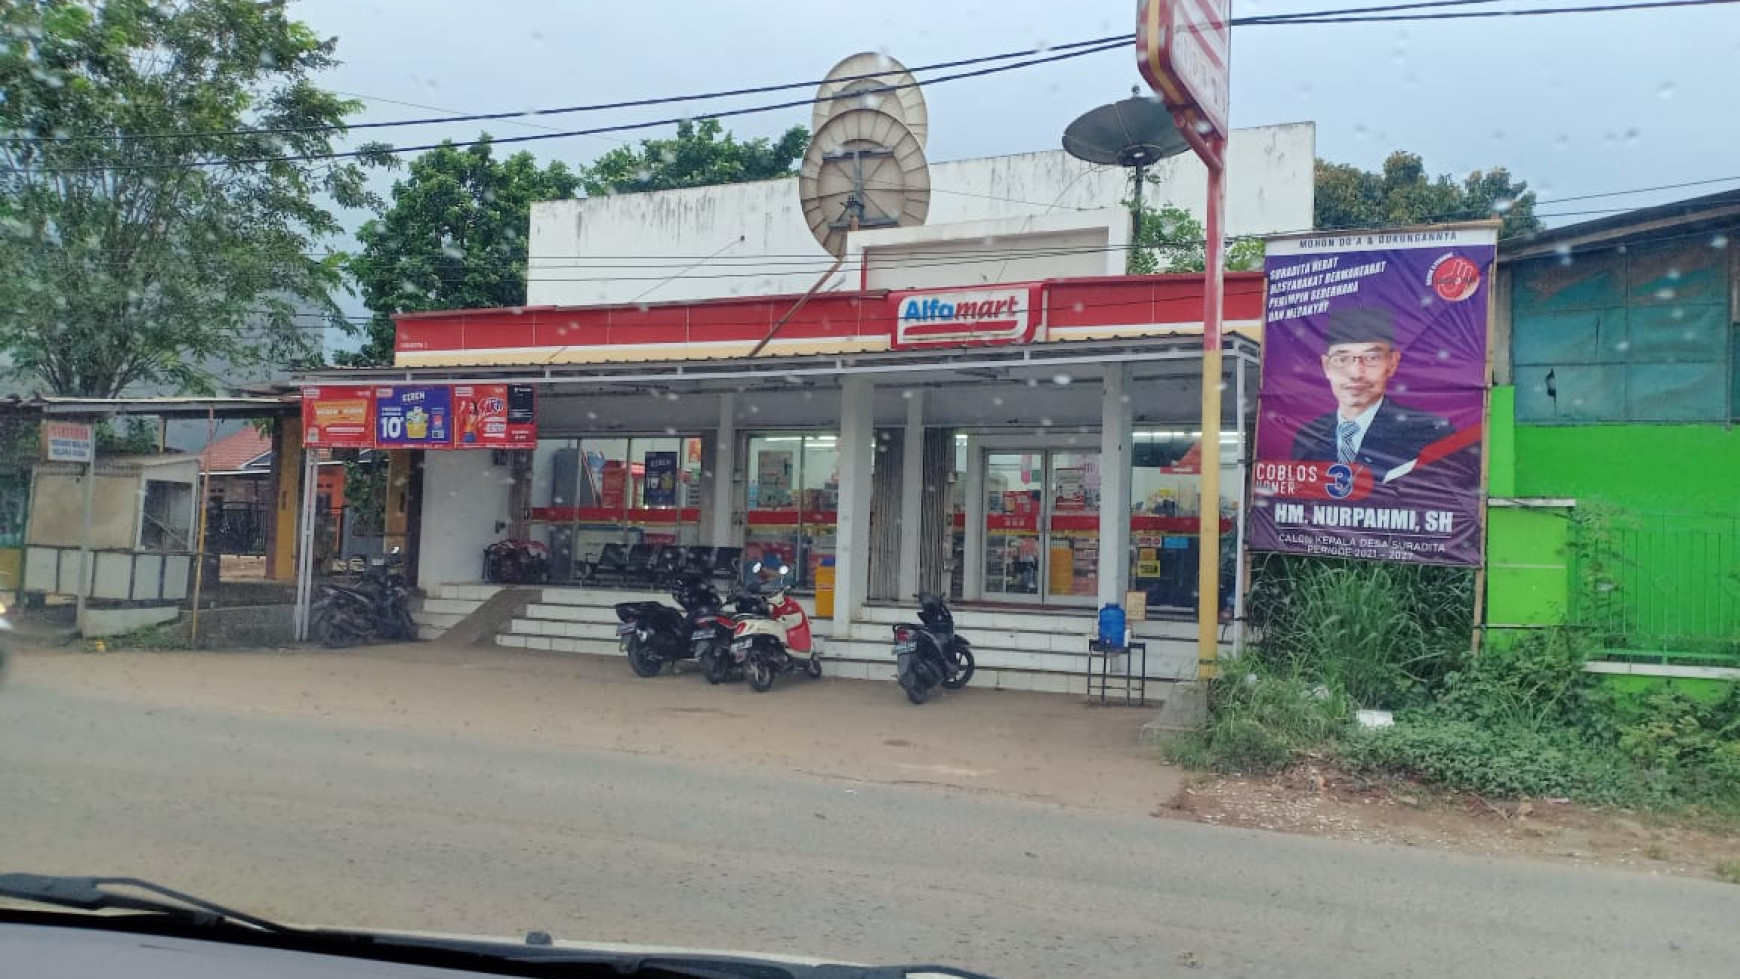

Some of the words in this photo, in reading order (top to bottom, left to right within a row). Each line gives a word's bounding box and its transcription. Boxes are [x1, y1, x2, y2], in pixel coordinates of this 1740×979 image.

[1299, 237, 1335, 249] MOHON
[1378, 231, 1457, 244] DUKUNGANNYA
[1312, 256, 1339, 273] HEBAT
[1269, 274, 1323, 294] MASYARAKAT
[1310, 281, 1359, 301] SEDERHANA
[904, 295, 1018, 321] Alfamart
[1268, 310, 1285, 322] DAN
[1256, 463, 1318, 483] COBLOS
[1325, 463, 1353, 499] 3
[1274, 503, 1308, 524] HM.
[1313, 505, 1420, 533] NURPAHMI,
[1425, 511, 1454, 533] SH
[1278, 533, 1313, 544] CALON
[1315, 535, 1356, 547] KEPALA
[1359, 537, 1389, 548] DESA
[1391, 540, 1446, 553] SURADITA
[1307, 545, 1351, 557] PERIODE
[1354, 549, 1377, 559] 2021
[1388, 550, 1414, 560] 2027
